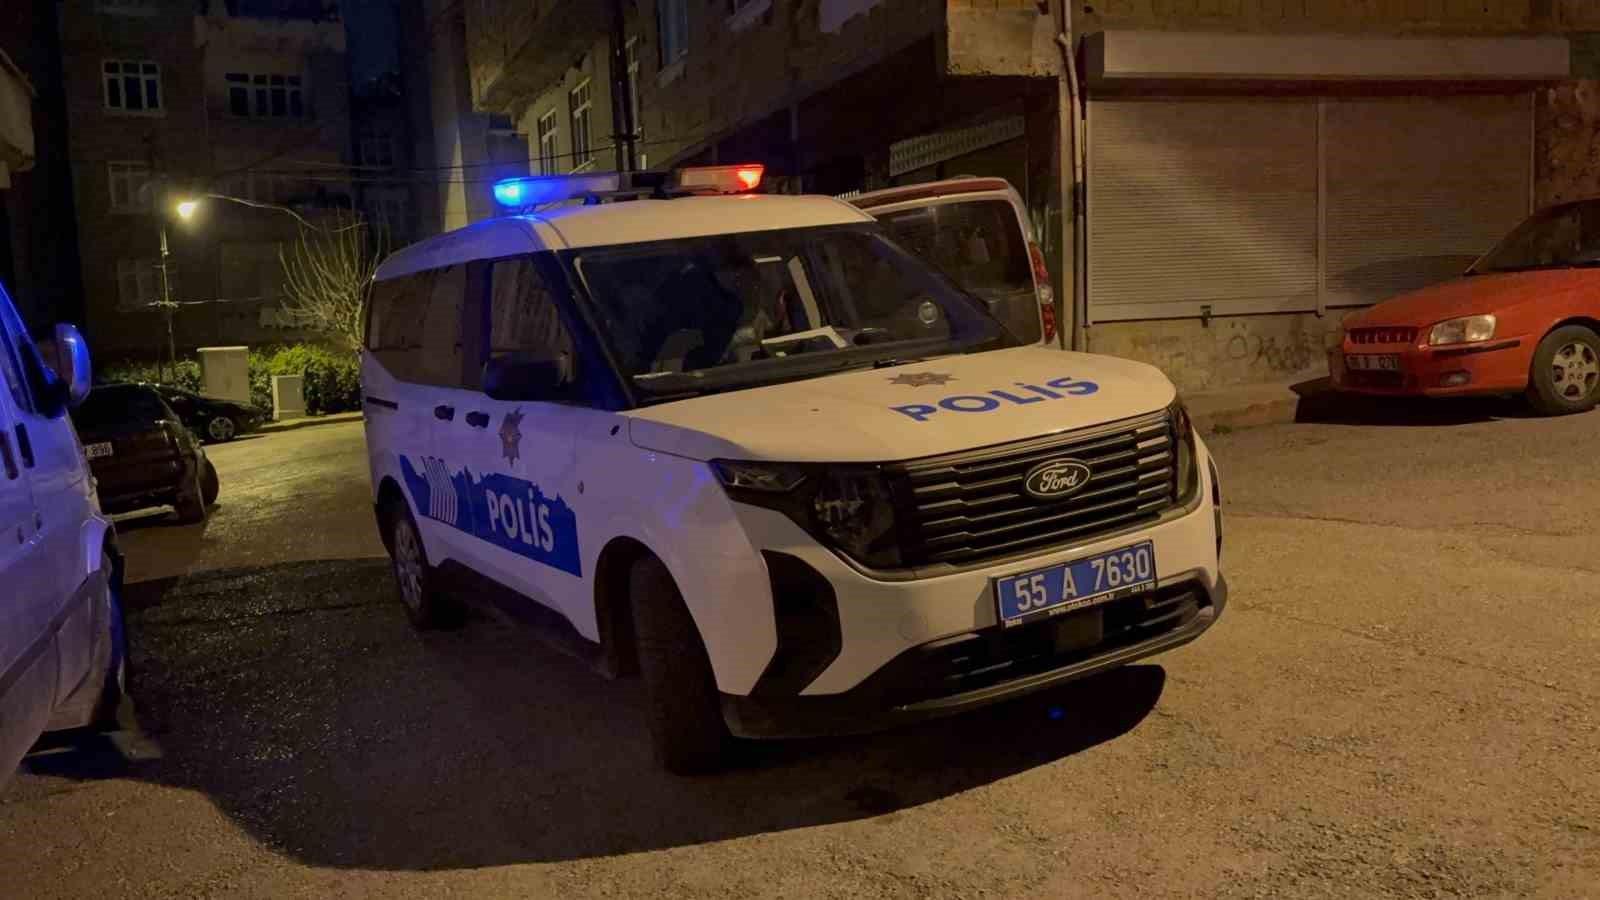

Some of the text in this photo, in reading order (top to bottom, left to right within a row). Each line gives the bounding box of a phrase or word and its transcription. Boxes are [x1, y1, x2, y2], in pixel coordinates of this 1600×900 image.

[888, 376, 1099, 421] POLİS
[1040, 467, 1078, 492] Ford
[485, 487, 555, 552] POLİS
[1014, 549, 1150, 612] 55 A 7630
